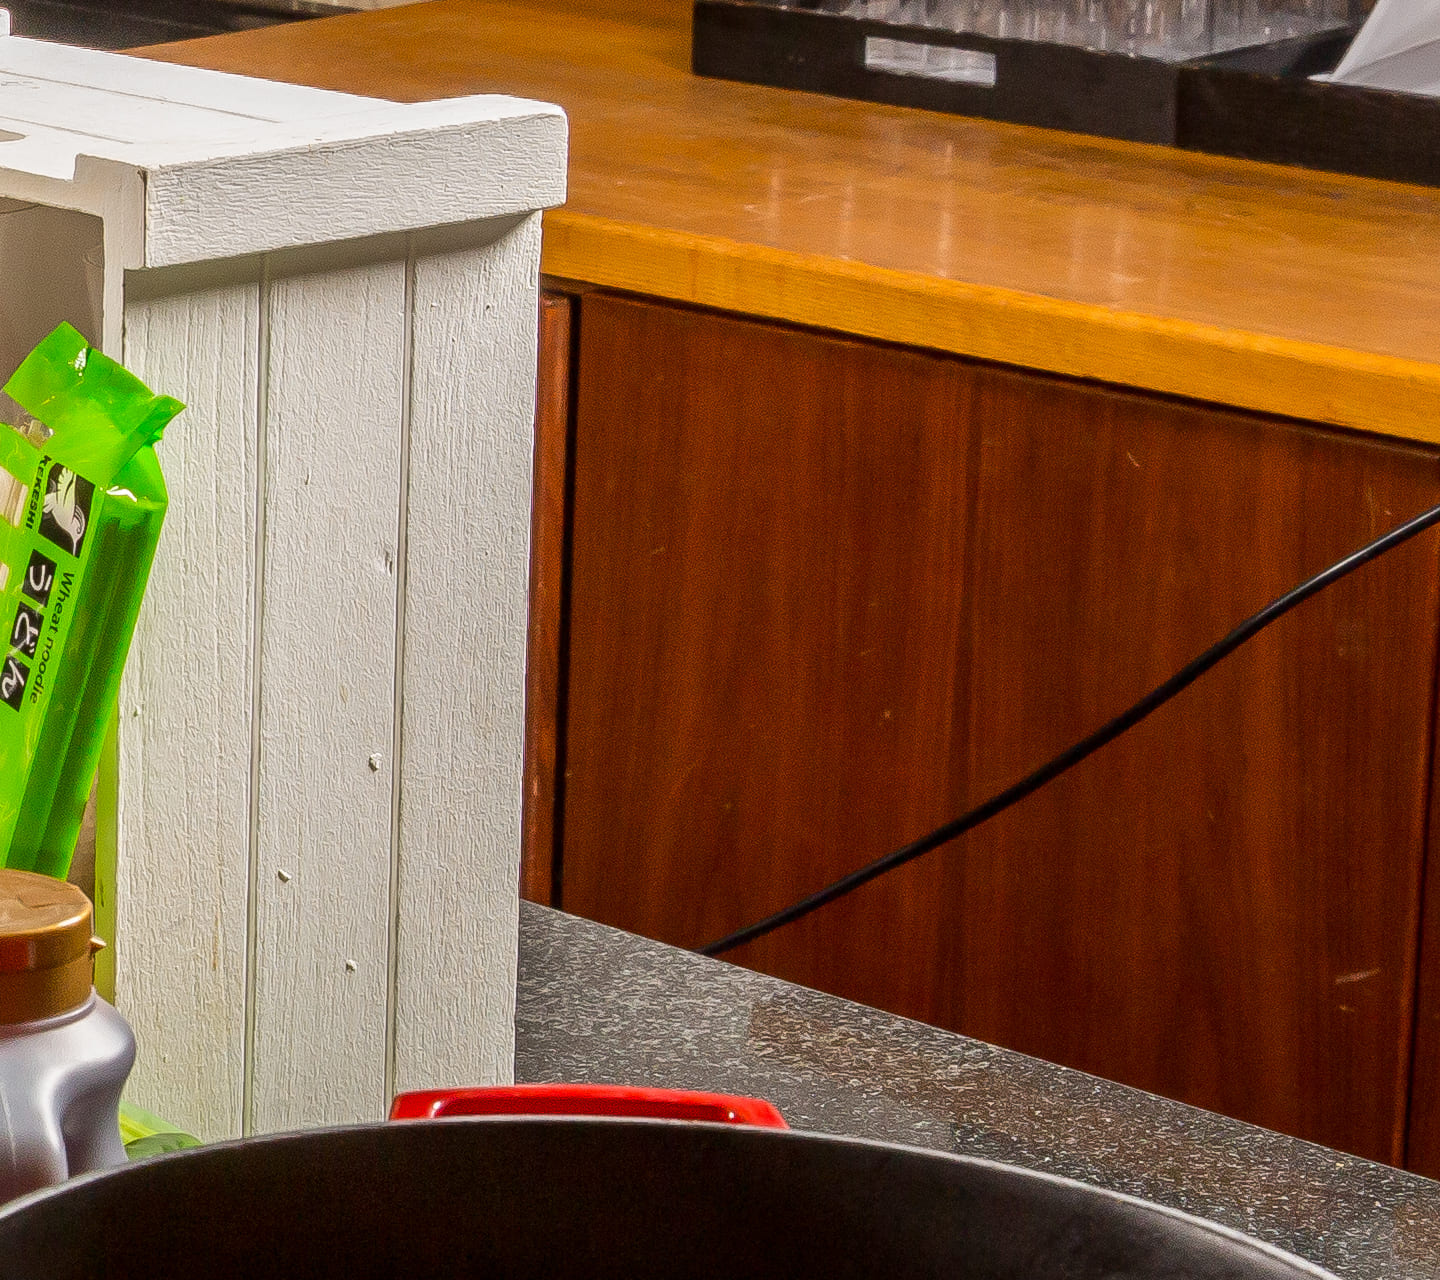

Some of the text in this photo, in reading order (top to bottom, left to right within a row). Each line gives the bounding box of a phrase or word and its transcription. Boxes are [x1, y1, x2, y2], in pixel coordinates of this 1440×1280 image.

[25, 453, 52, 531] KEKESHI
[30, 570, 75, 706] Wheat noodle
